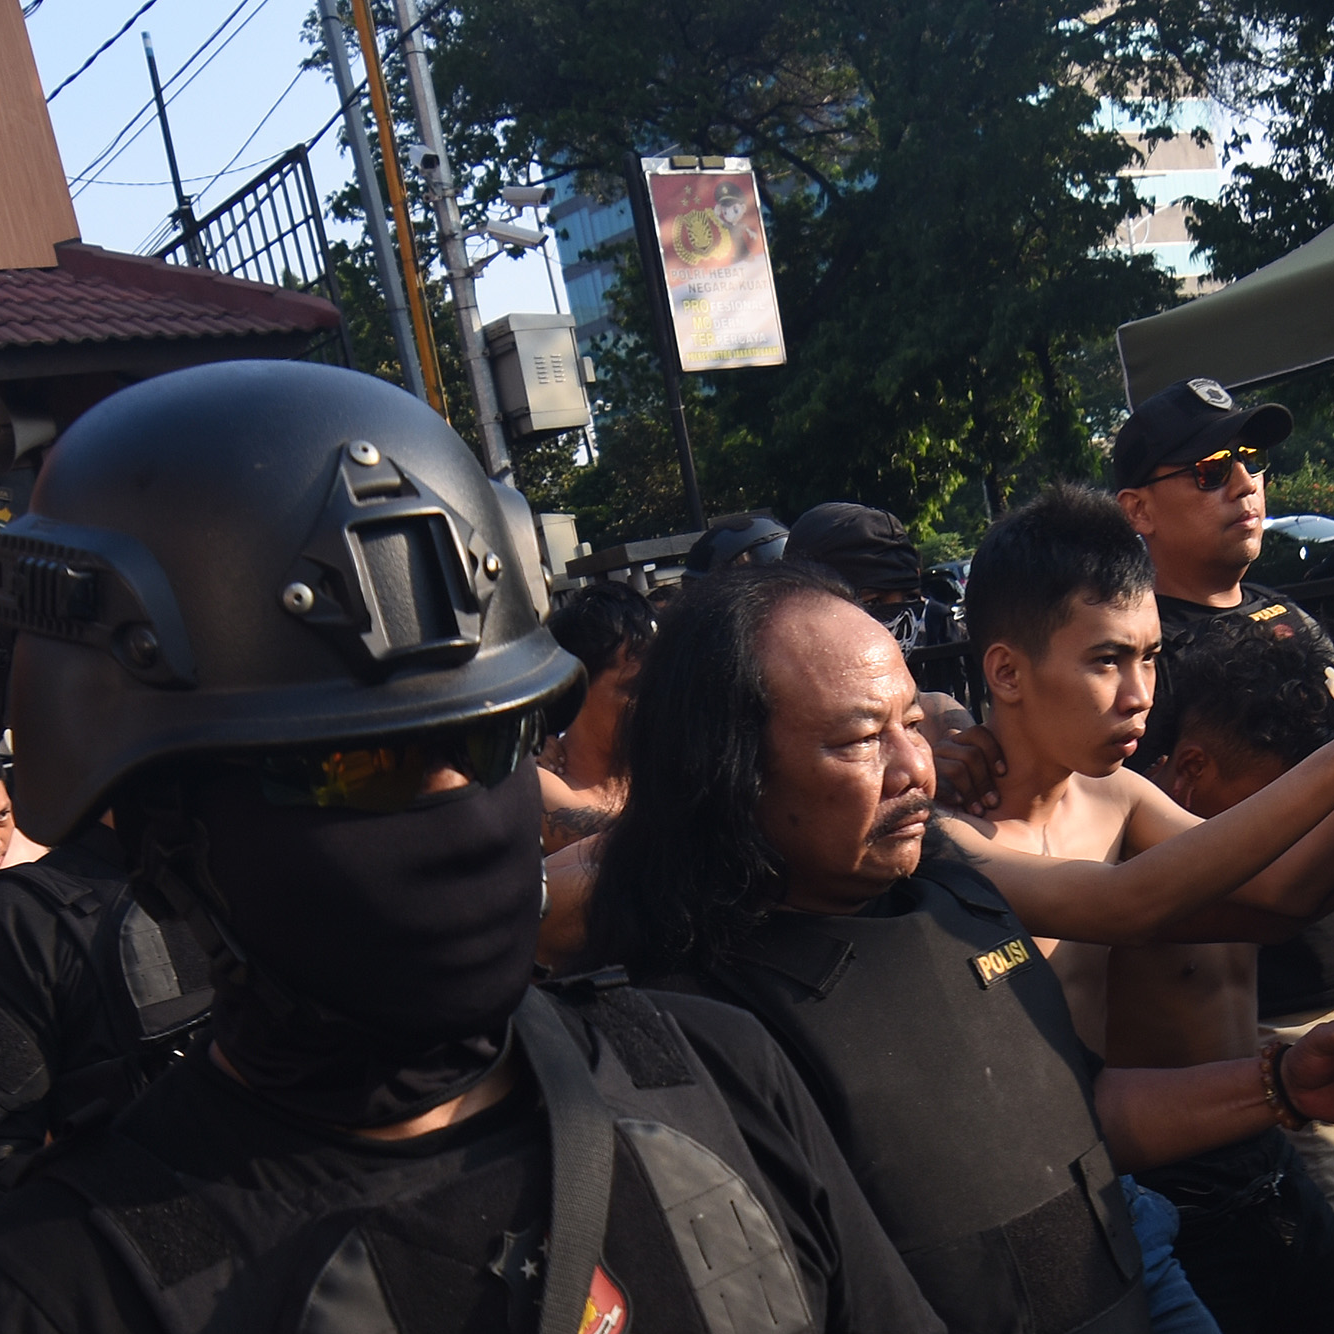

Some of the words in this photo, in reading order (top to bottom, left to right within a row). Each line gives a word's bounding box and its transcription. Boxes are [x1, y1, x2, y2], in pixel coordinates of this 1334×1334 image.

[671, 268, 704, 281] POLRI
[710, 267, 745, 279] HEBAT
[688, 281, 736, 294] NEGARA
[739, 279, 768, 291] KUAT
[682, 298, 767, 313] PROFESIONAL
[977, 939, 1030, 981] POLISI
